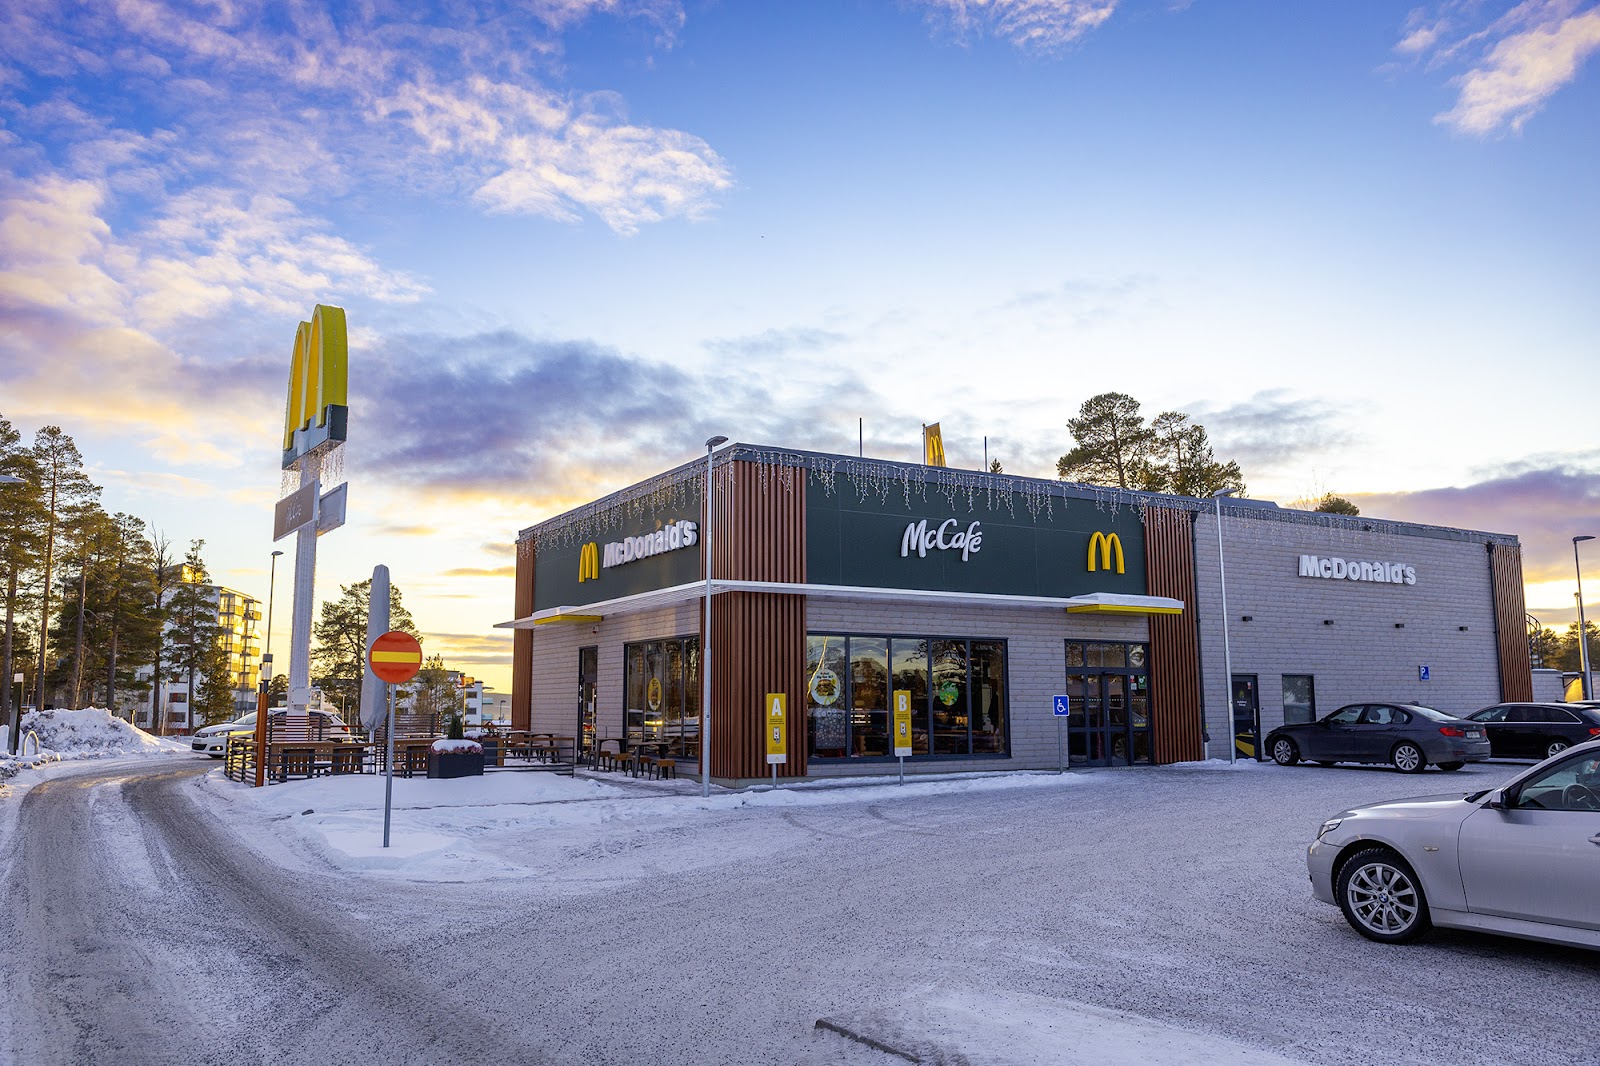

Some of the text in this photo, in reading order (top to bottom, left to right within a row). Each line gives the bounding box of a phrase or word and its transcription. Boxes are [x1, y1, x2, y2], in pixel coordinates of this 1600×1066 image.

[603, 520, 697, 568] McDonald's
[900, 518, 982, 562] McCafé
[1298, 554, 1417, 585] McDonald's
[771, 697, 782, 716] A
[898, 694, 908, 712] B
